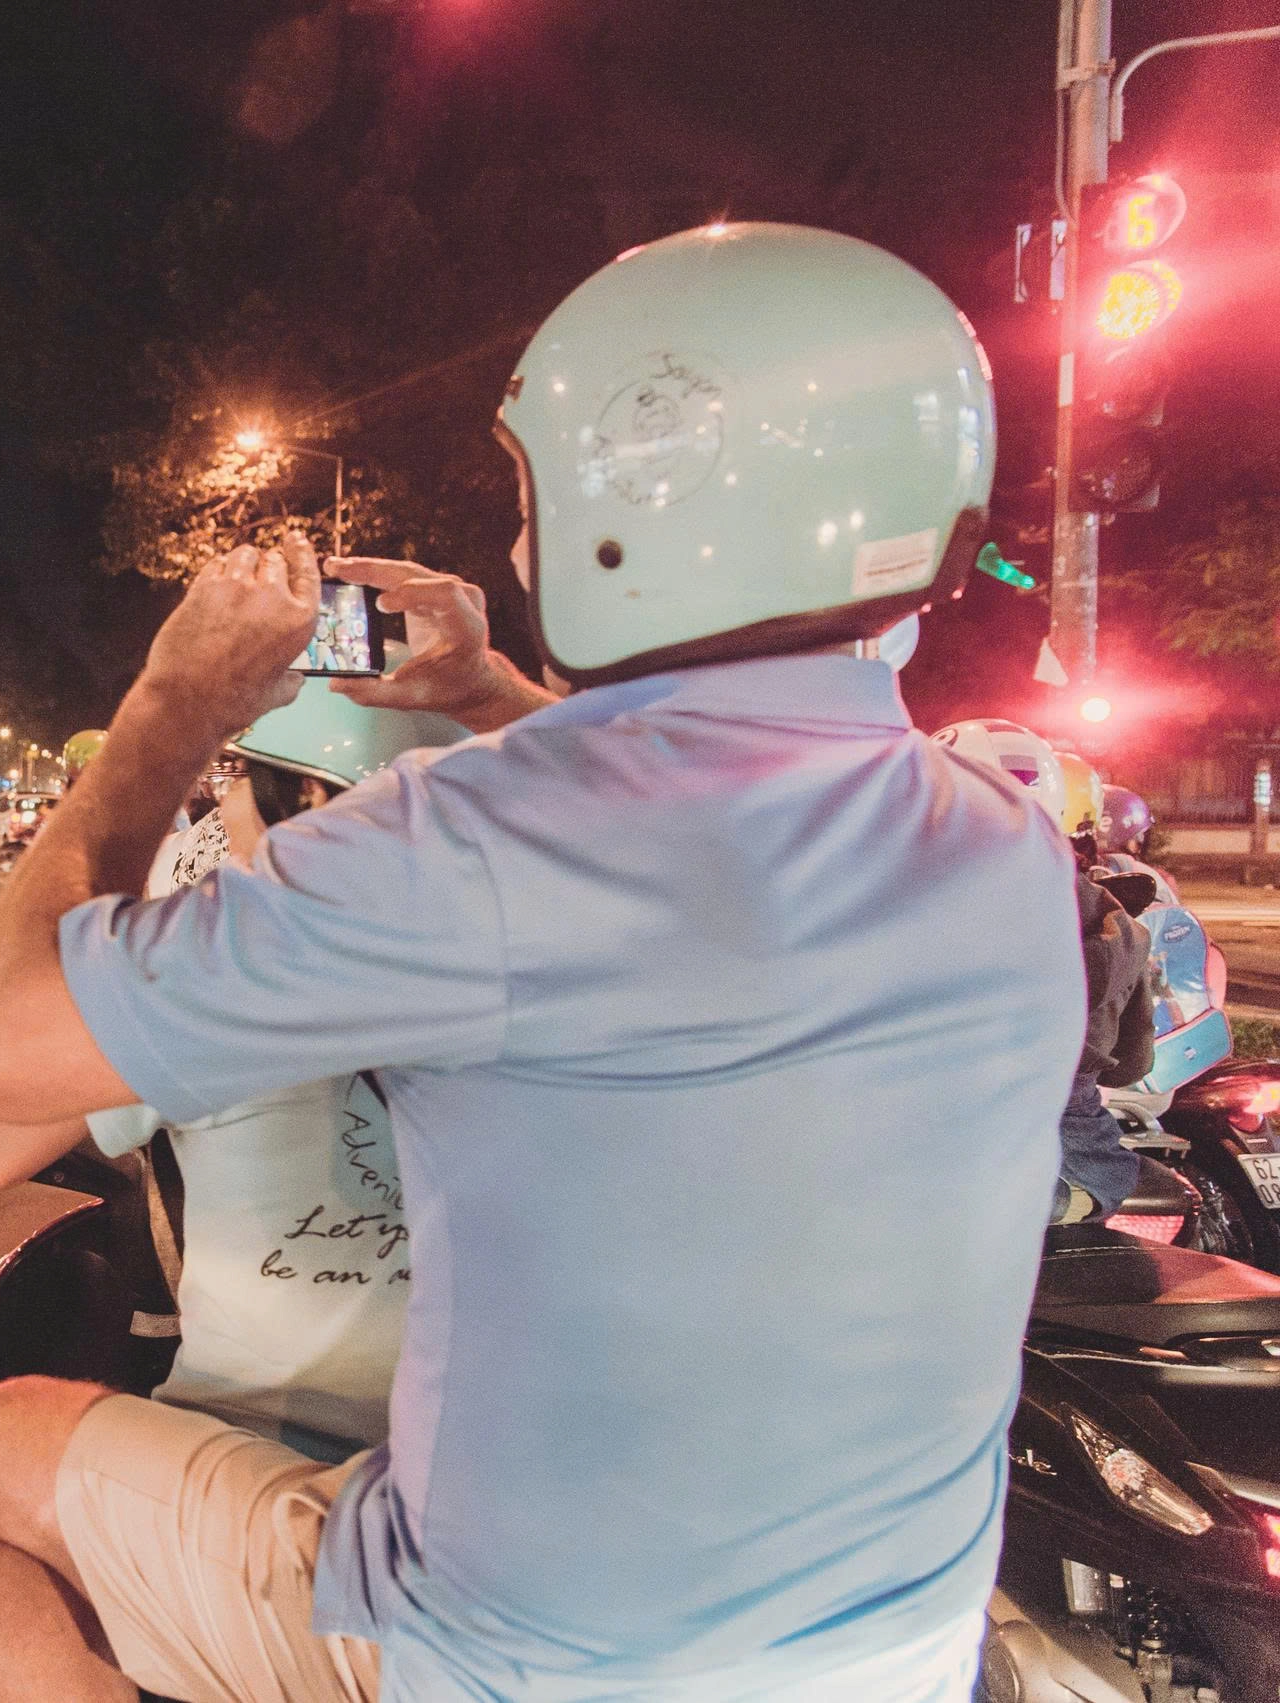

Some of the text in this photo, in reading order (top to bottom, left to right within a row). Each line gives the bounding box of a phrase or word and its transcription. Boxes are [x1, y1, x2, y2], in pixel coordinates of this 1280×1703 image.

[1127, 194, 1156, 247] 6
[284, 1205, 387, 1239] Let
[260, 1248, 299, 1280] be
[312, 1268, 372, 1285] an
